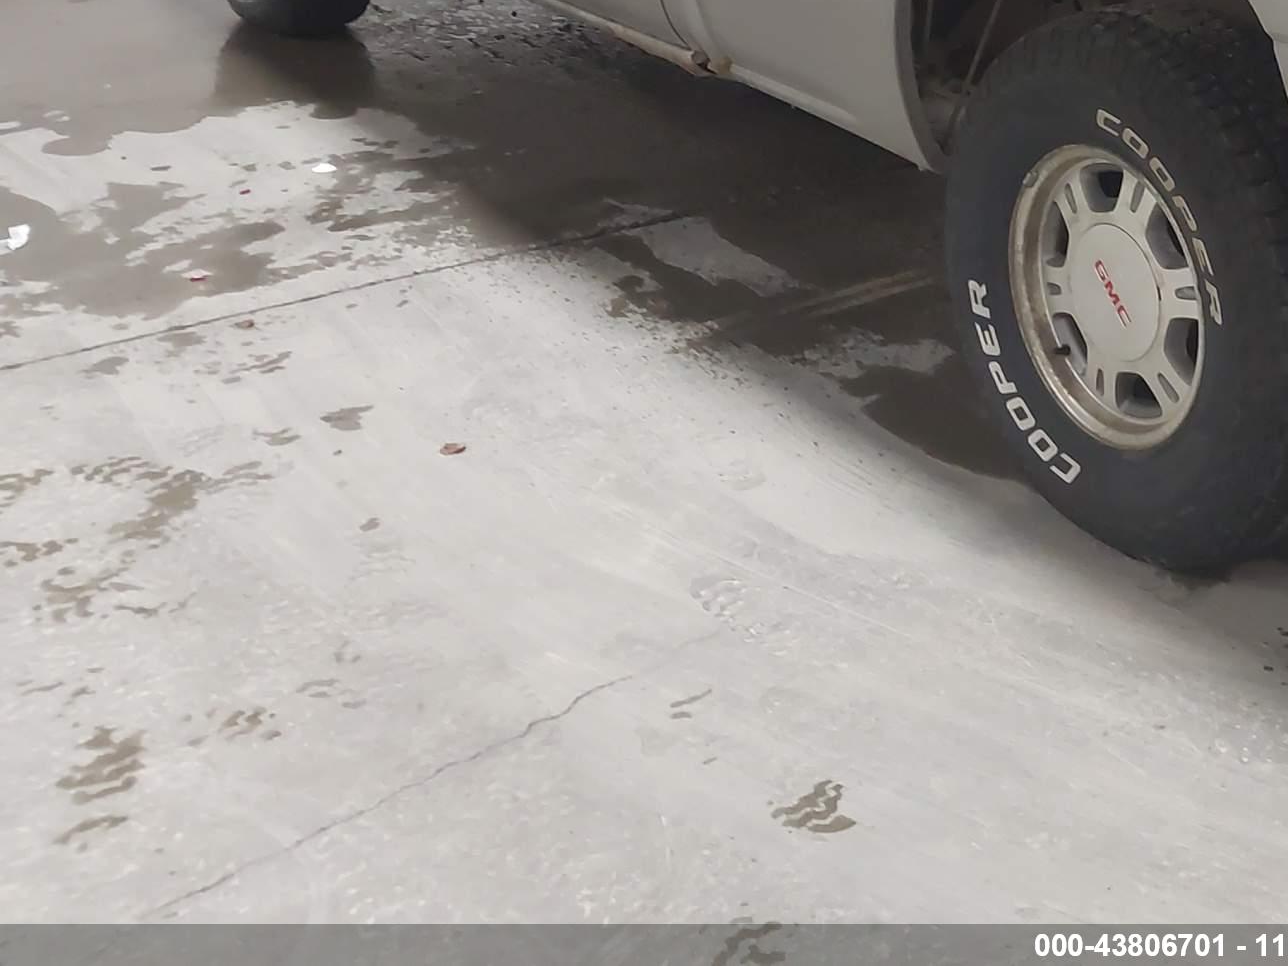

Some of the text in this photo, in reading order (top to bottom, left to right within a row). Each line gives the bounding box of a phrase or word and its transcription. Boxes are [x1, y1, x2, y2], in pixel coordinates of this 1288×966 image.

[1093, 259, 1132, 329] GMC
[1096, 108, 1223, 325] COOPER
[967, 279, 1081, 485] COOPER
